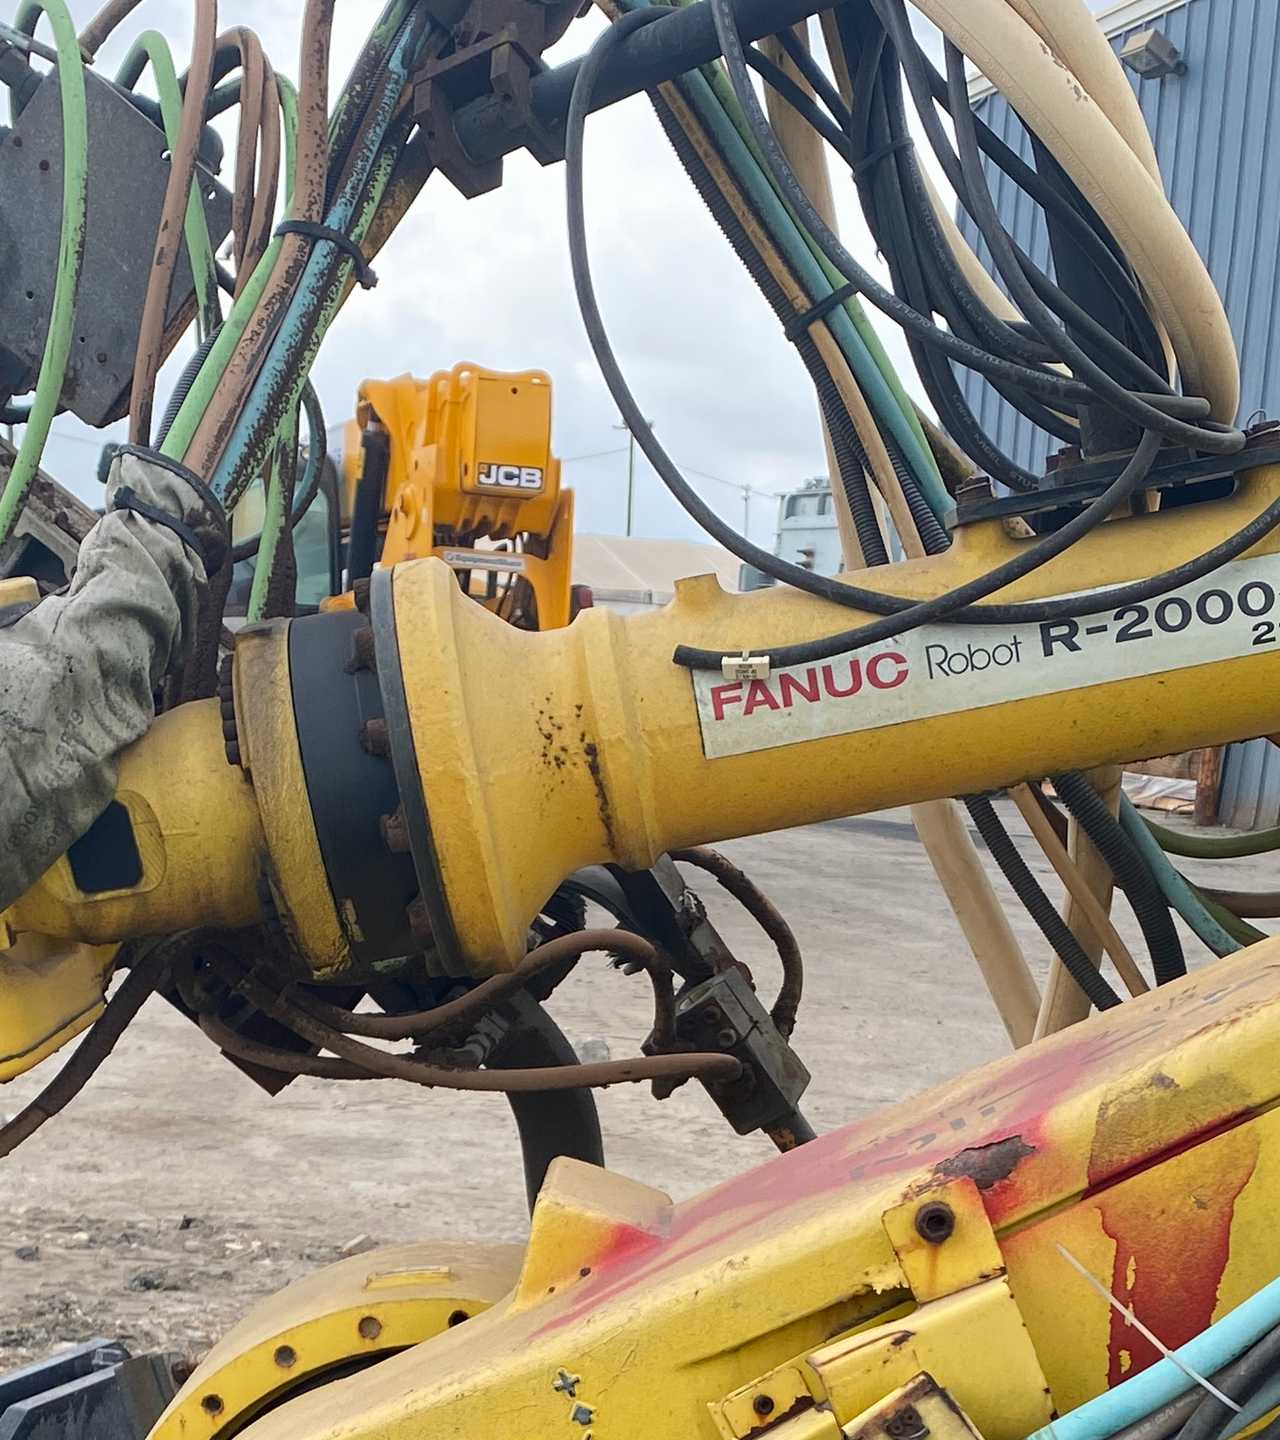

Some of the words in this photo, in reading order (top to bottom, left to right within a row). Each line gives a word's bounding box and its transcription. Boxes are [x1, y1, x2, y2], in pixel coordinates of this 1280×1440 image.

[478, 464, 542, 489] JCB
[710, 651, 910, 722] FANUC
[926, 635, 1023, 680] Robot
